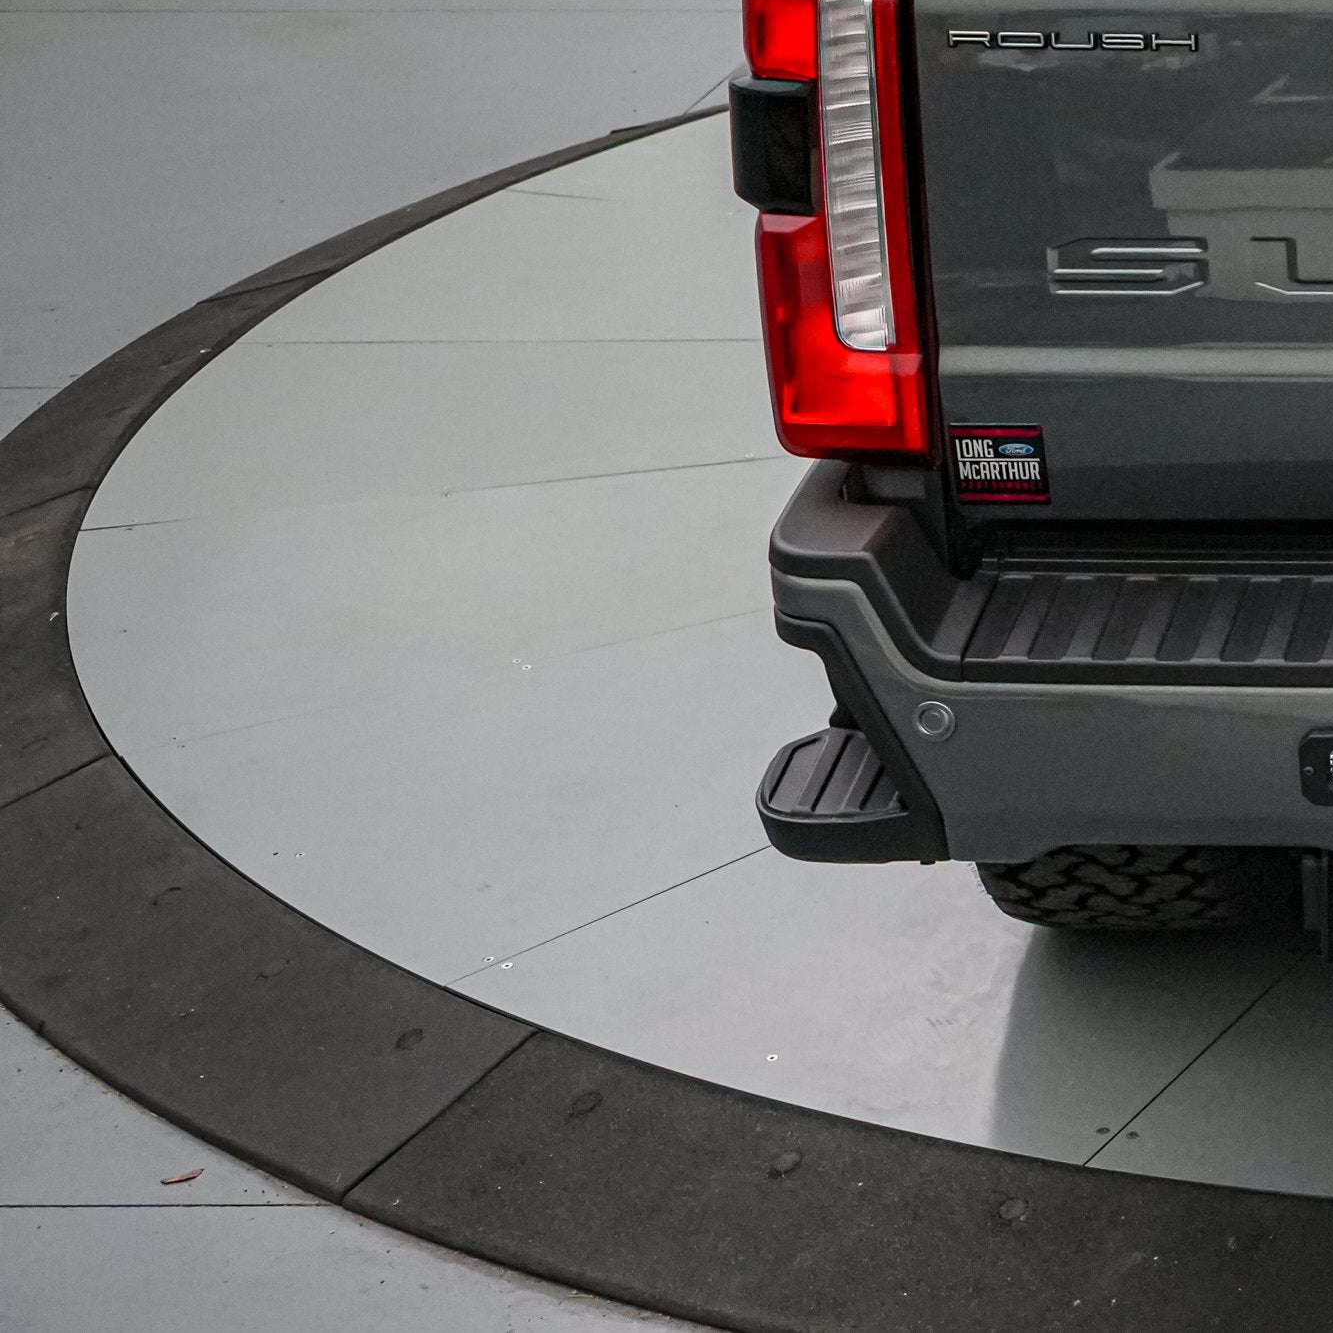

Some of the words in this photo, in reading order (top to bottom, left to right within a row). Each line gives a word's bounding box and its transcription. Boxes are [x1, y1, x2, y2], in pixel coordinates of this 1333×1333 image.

[948, 30, 1196, 52] ROUSH
[955, 439, 994, 460] LONG
[959, 462, 1040, 480] McARTHUR
